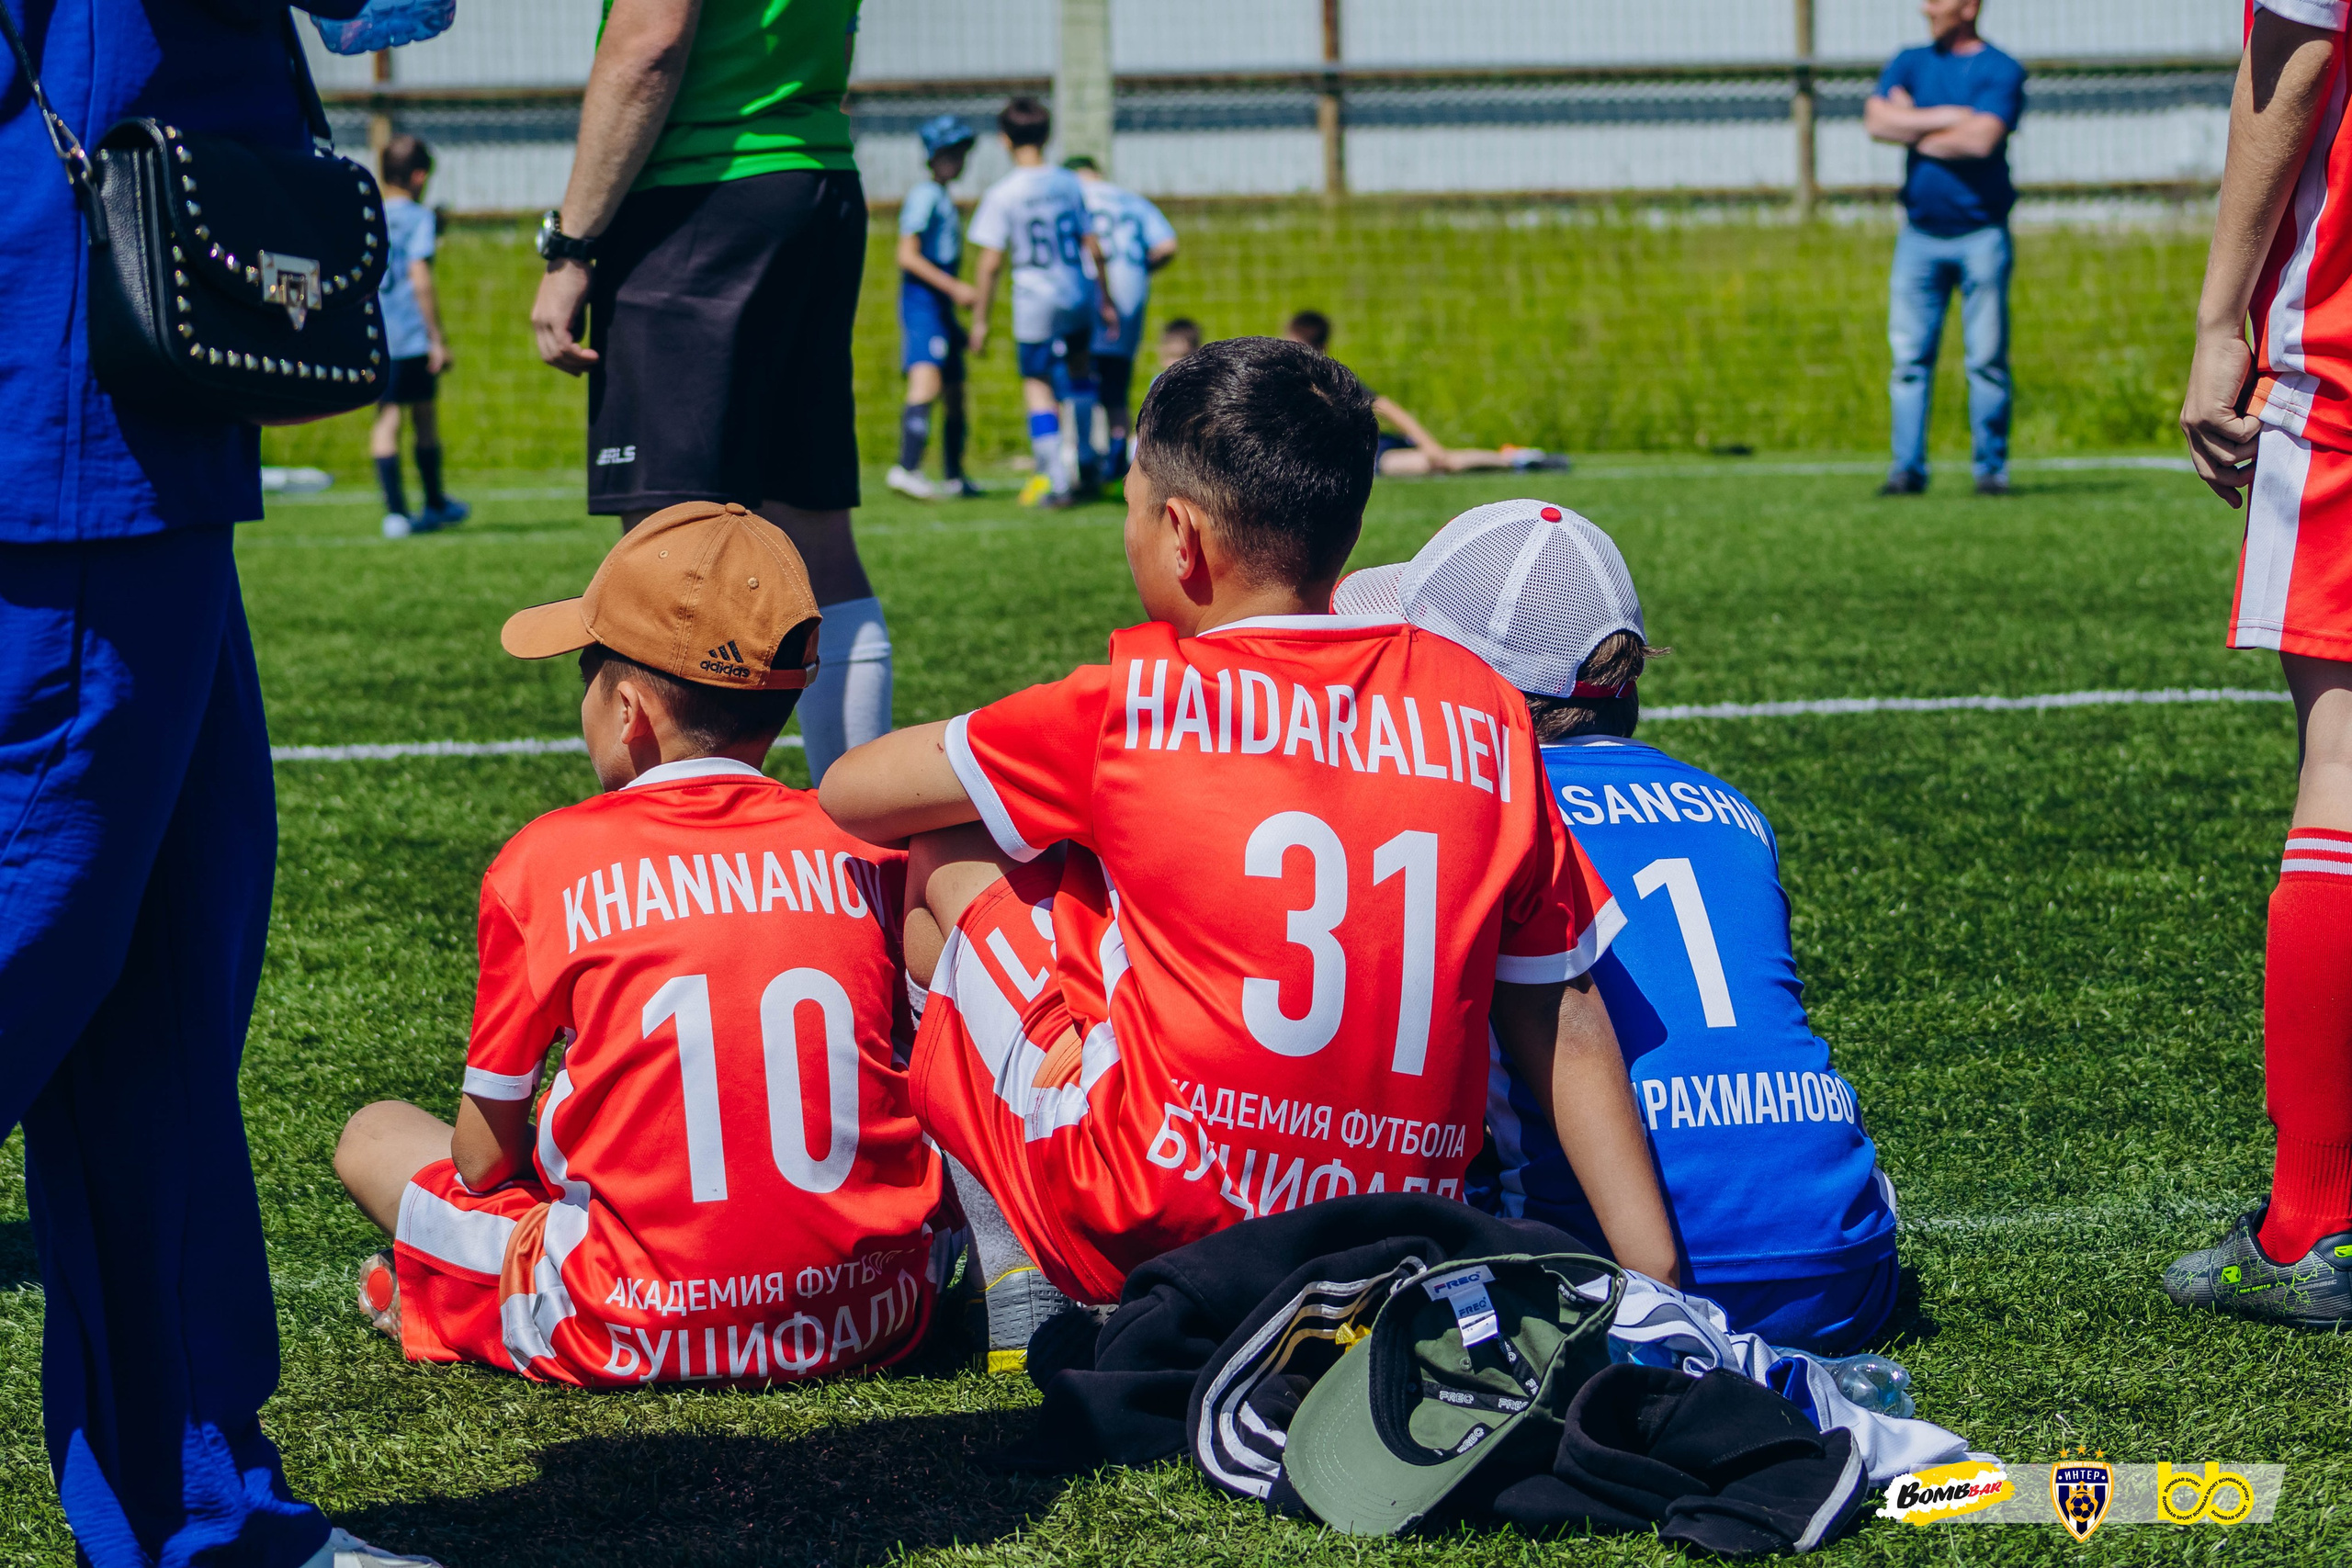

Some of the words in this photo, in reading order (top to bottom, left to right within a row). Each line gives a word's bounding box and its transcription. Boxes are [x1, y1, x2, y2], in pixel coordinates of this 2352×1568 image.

[699, 660, 751, 678] adidas
[1125, 659, 1511, 803] HAIDARALIEV
[562, 850, 886, 953] KHANNANOV
[1242, 811, 1439, 1077] 31
[1632, 857, 1737, 1029] 1
[642, 967, 860, 1203] 10
[1170, 1078, 1332, 1141] АДЕМИЯ
[1340, 1108, 1466, 1158] ФУТБОЛА
[1632, 1071, 1855, 1137] РАХМАНОВО
[1146, 1101, 1459, 1221] БУЦИФ
[605, 1271, 785, 1316] АКАДЕМИЯ
[1433, 1273, 1480, 1293] FREQ
[1458, 1300, 1487, 1317] FREQ
[1439, 1390, 1475, 1404] FREQ
